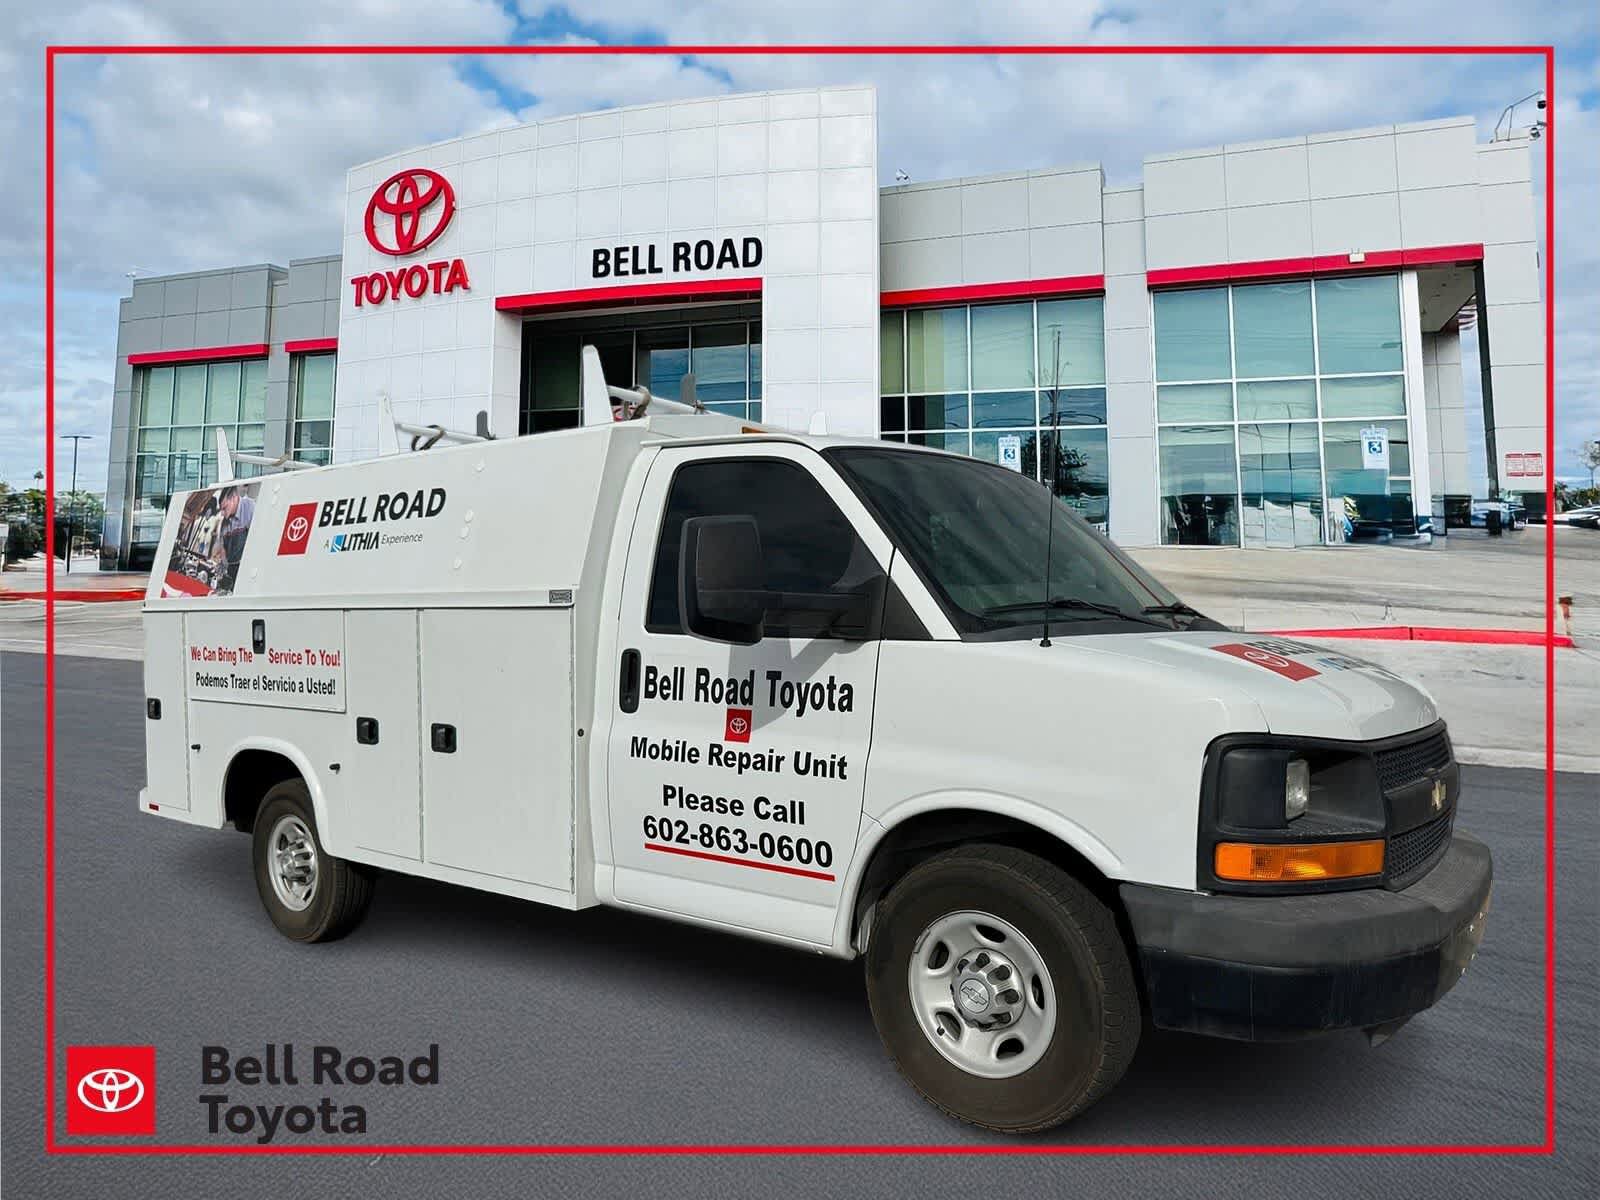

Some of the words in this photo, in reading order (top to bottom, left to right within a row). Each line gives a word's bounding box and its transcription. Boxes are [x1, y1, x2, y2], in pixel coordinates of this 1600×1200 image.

[592, 243, 663, 278] BELL
[672, 236, 763, 273] ROAD
[351, 259, 470, 308] TOYOTA
[319, 497, 367, 528] BELL
[373, 488, 446, 522] ROAD
[341, 531, 380, 552] LITHIA
[381, 533, 423, 545] Experience
[190, 646, 202, 661] We
[203, 647, 216, 662] Can
[218, 646, 237, 666] Bring
[239, 647, 253, 663] The
[268, 648, 302, 665] Service
[305, 650, 317, 665] To
[319, 649, 341, 667] You!
[195, 672, 229, 689] Podemos
[230, 674, 251, 690] Traer
[253, 675, 260, 691] el
[262, 676, 297, 693] Servicio
[298, 680, 304, 693] a
[306, 677, 336, 696] Usted!
[644, 665, 685, 701] Bell
[694, 667, 755, 706] Road
[766, 670, 854, 717] Toyota
[630, 736, 700, 764] Mobile
[708, 743, 785, 775] Repair
[794, 751, 848, 780] Unit
[663, 784, 745, 816] Please
[753, 796, 805, 825] Call
[643, 815, 833, 868] 602-863-0600
